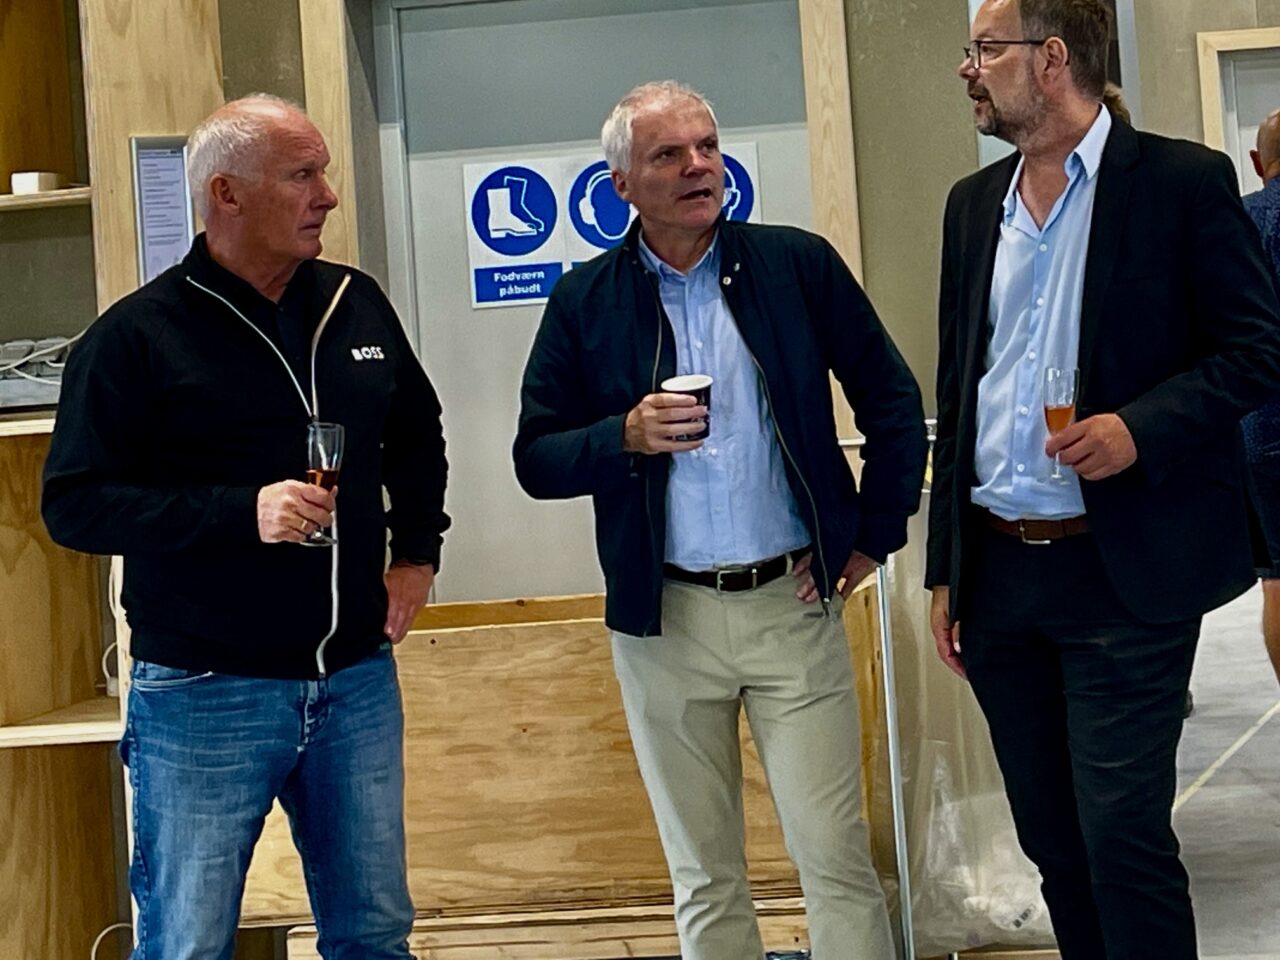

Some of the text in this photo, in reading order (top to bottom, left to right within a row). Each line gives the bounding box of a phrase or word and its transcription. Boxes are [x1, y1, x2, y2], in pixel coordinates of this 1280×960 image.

[493, 271, 544, 282] Fodværn
[499, 283, 541, 297] påbudt
[351, 346, 384, 360] BOSS
